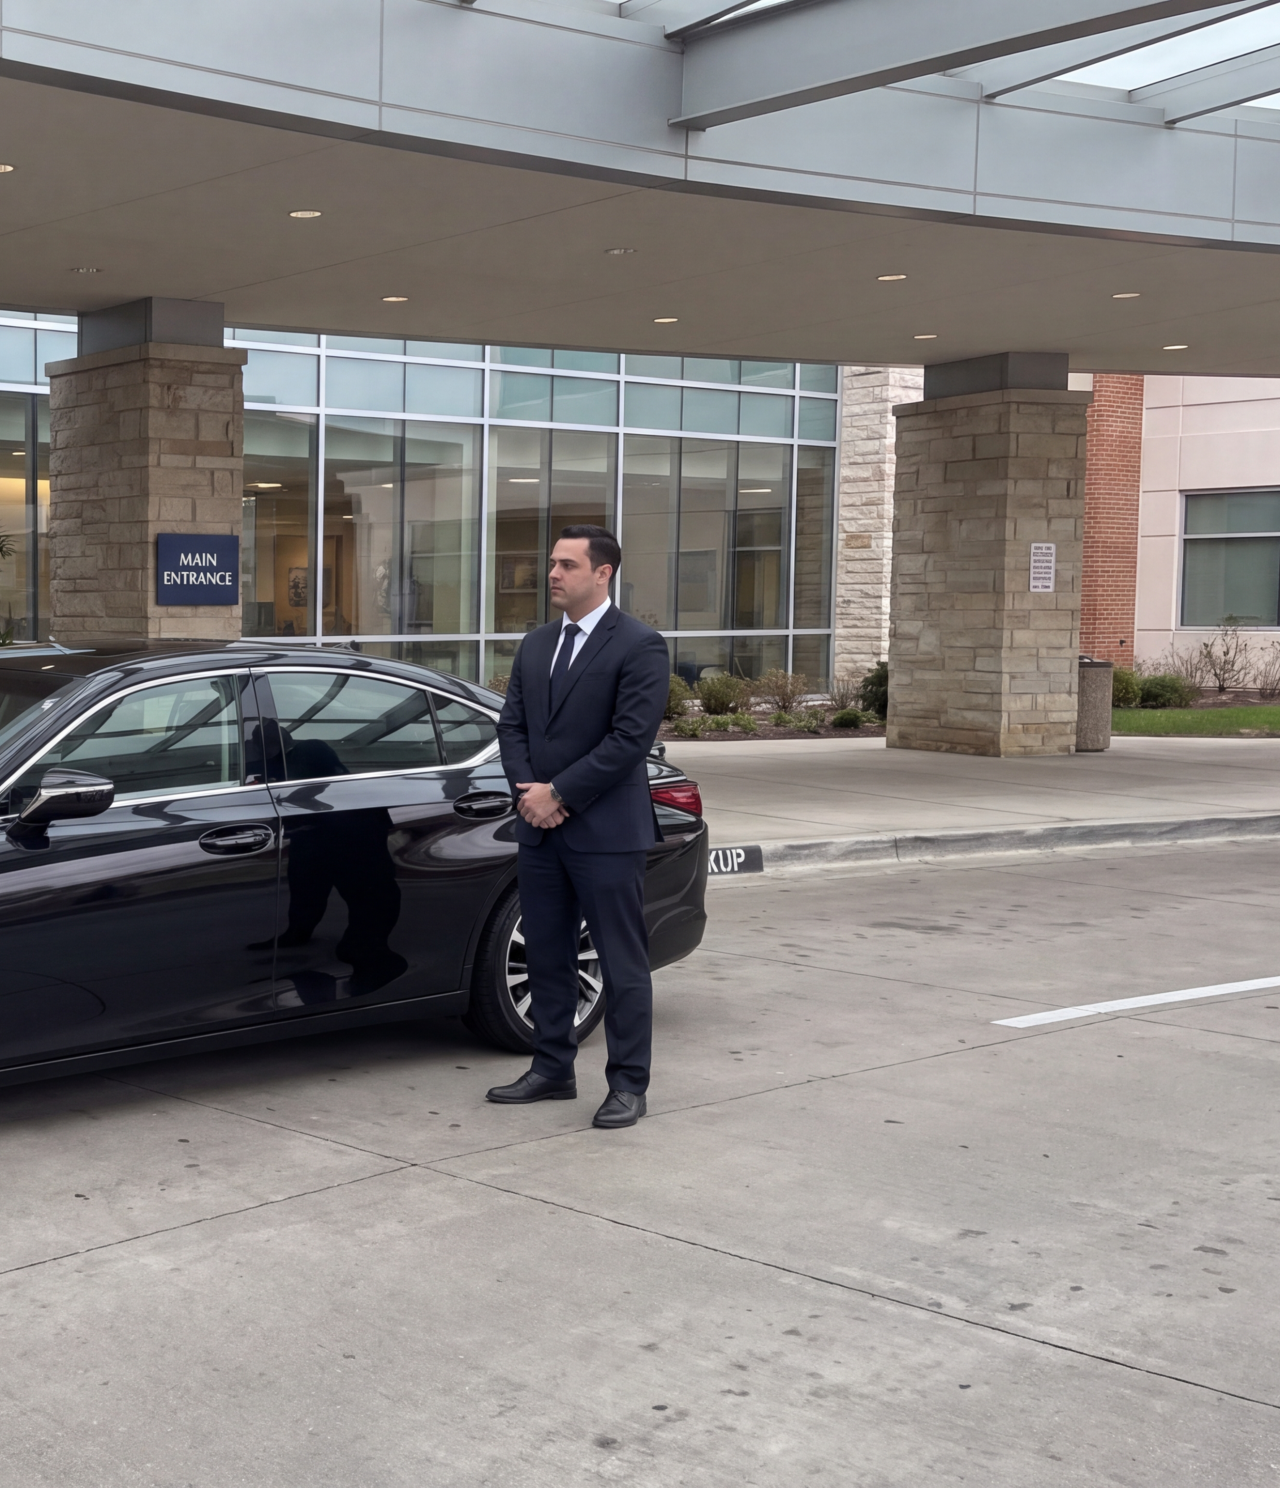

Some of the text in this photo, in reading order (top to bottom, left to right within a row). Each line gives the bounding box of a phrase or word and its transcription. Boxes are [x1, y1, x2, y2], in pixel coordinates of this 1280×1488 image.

[179, 552, 217, 567] MAIN
[163, 571, 233, 585] ENTRANCE
[708, 848, 746, 873] KUP
